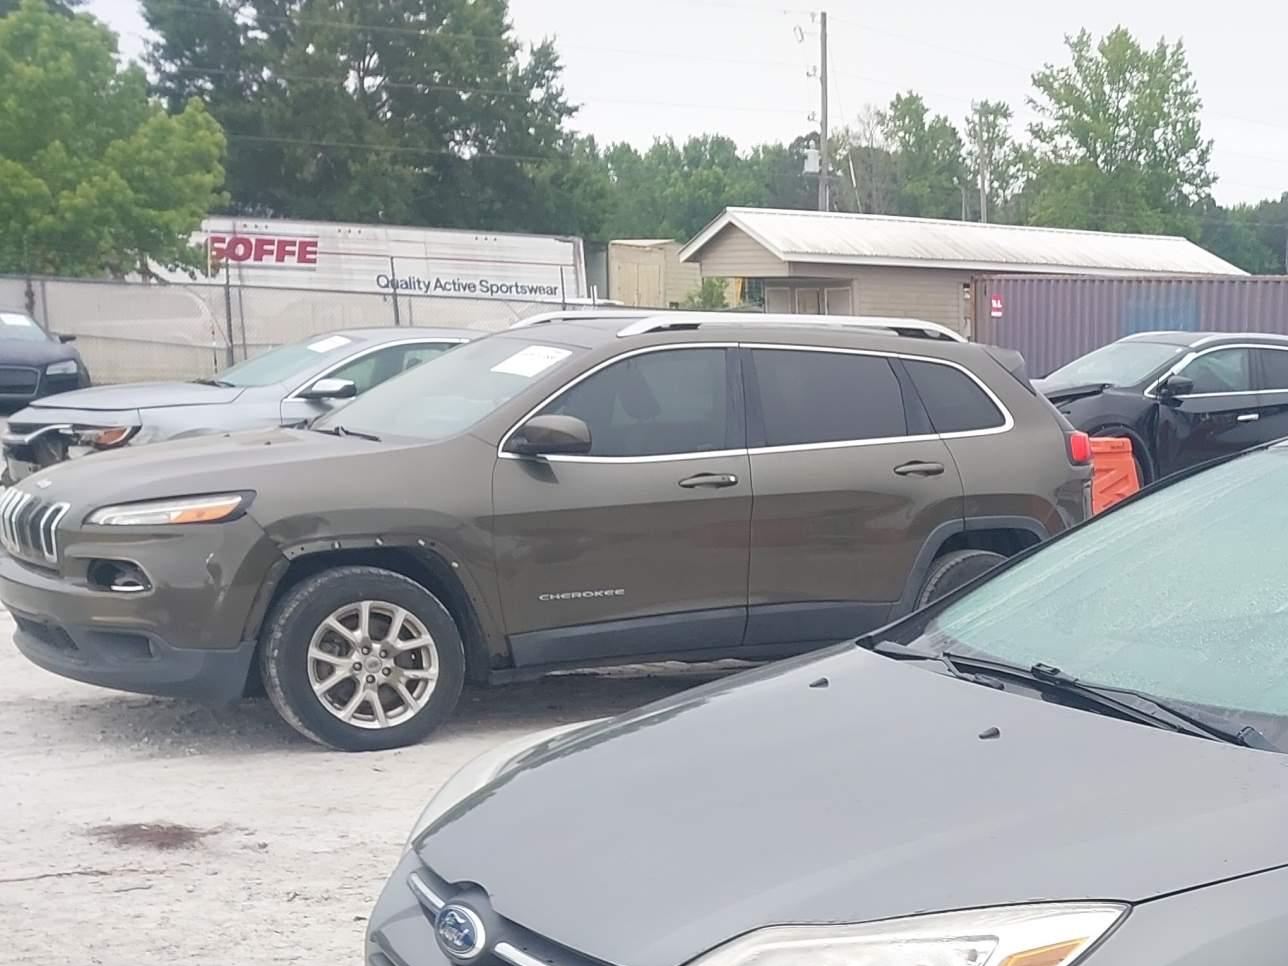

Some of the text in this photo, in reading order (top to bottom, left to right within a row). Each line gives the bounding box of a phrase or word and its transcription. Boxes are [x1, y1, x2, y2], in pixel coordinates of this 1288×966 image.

[376, 273, 559, 296] Quality Active Sportswear
[539, 588, 625, 601] CHEROKEE
